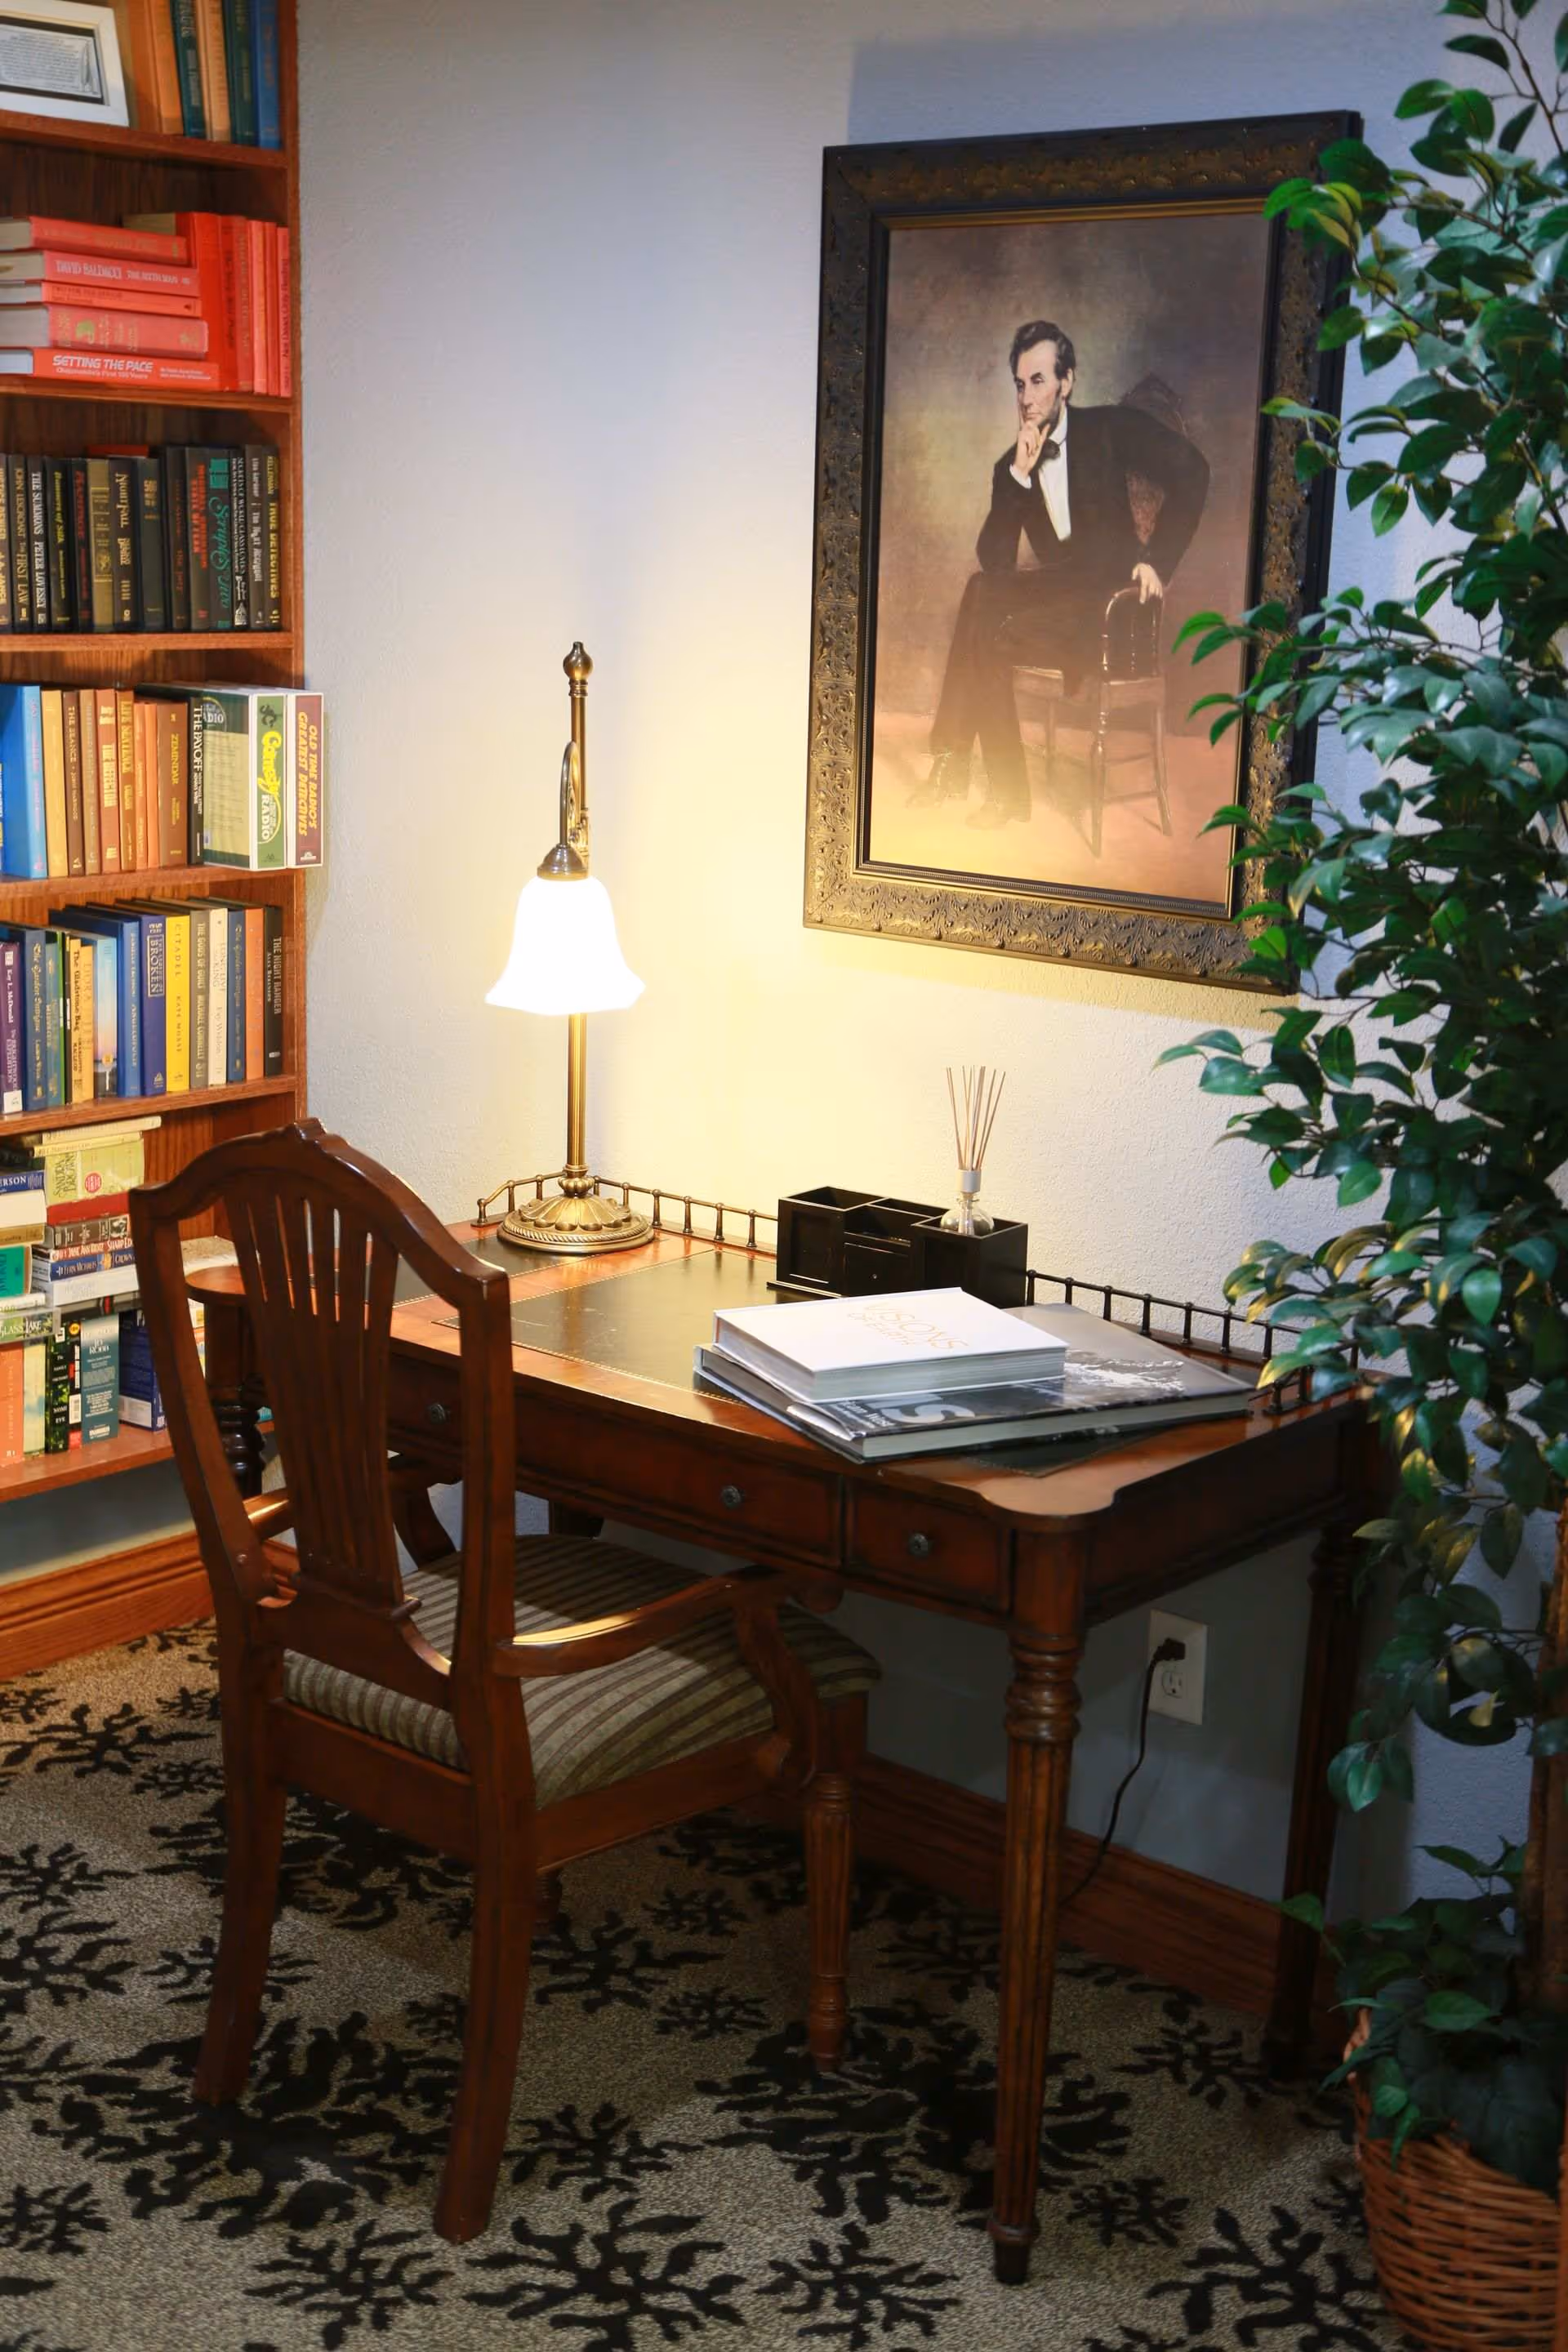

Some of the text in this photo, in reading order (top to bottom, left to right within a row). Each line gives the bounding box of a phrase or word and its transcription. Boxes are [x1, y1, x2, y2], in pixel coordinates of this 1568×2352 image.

[52, 355, 154, 372] SETTING THE PACE
[15, 468, 24, 490] JOHN
[252, 512, 261, 524] The
[31, 472, 47, 608] THE SUMMONS PETER LOVESEY
[269, 502, 279, 599] TRUE DETECTIVES
[16, 554, 27, 580] FIRST
[17, 583, 28, 605] LAW
[68, 706, 76, 726] THE
[121, 701, 132, 723] LIFE
[201, 711, 225, 724] ADIO
[193, 706, 203, 772] THE PAYOFF
[171, 733, 179, 785] ZEMINDAR
[257, 731, 283, 798] Comedy
[298, 712, 308, 836] GREATEST DETECTIVES
[308, 724, 318, 829] OLD TIME RADIO'S
[261, 794, 270, 840] RADIO
[197, 923, 205, 935] THE
[197, 938, 205, 957] GODS
[150, 938, 158, 993] BROKEN
[73, 1016, 81, 1032] Bag
